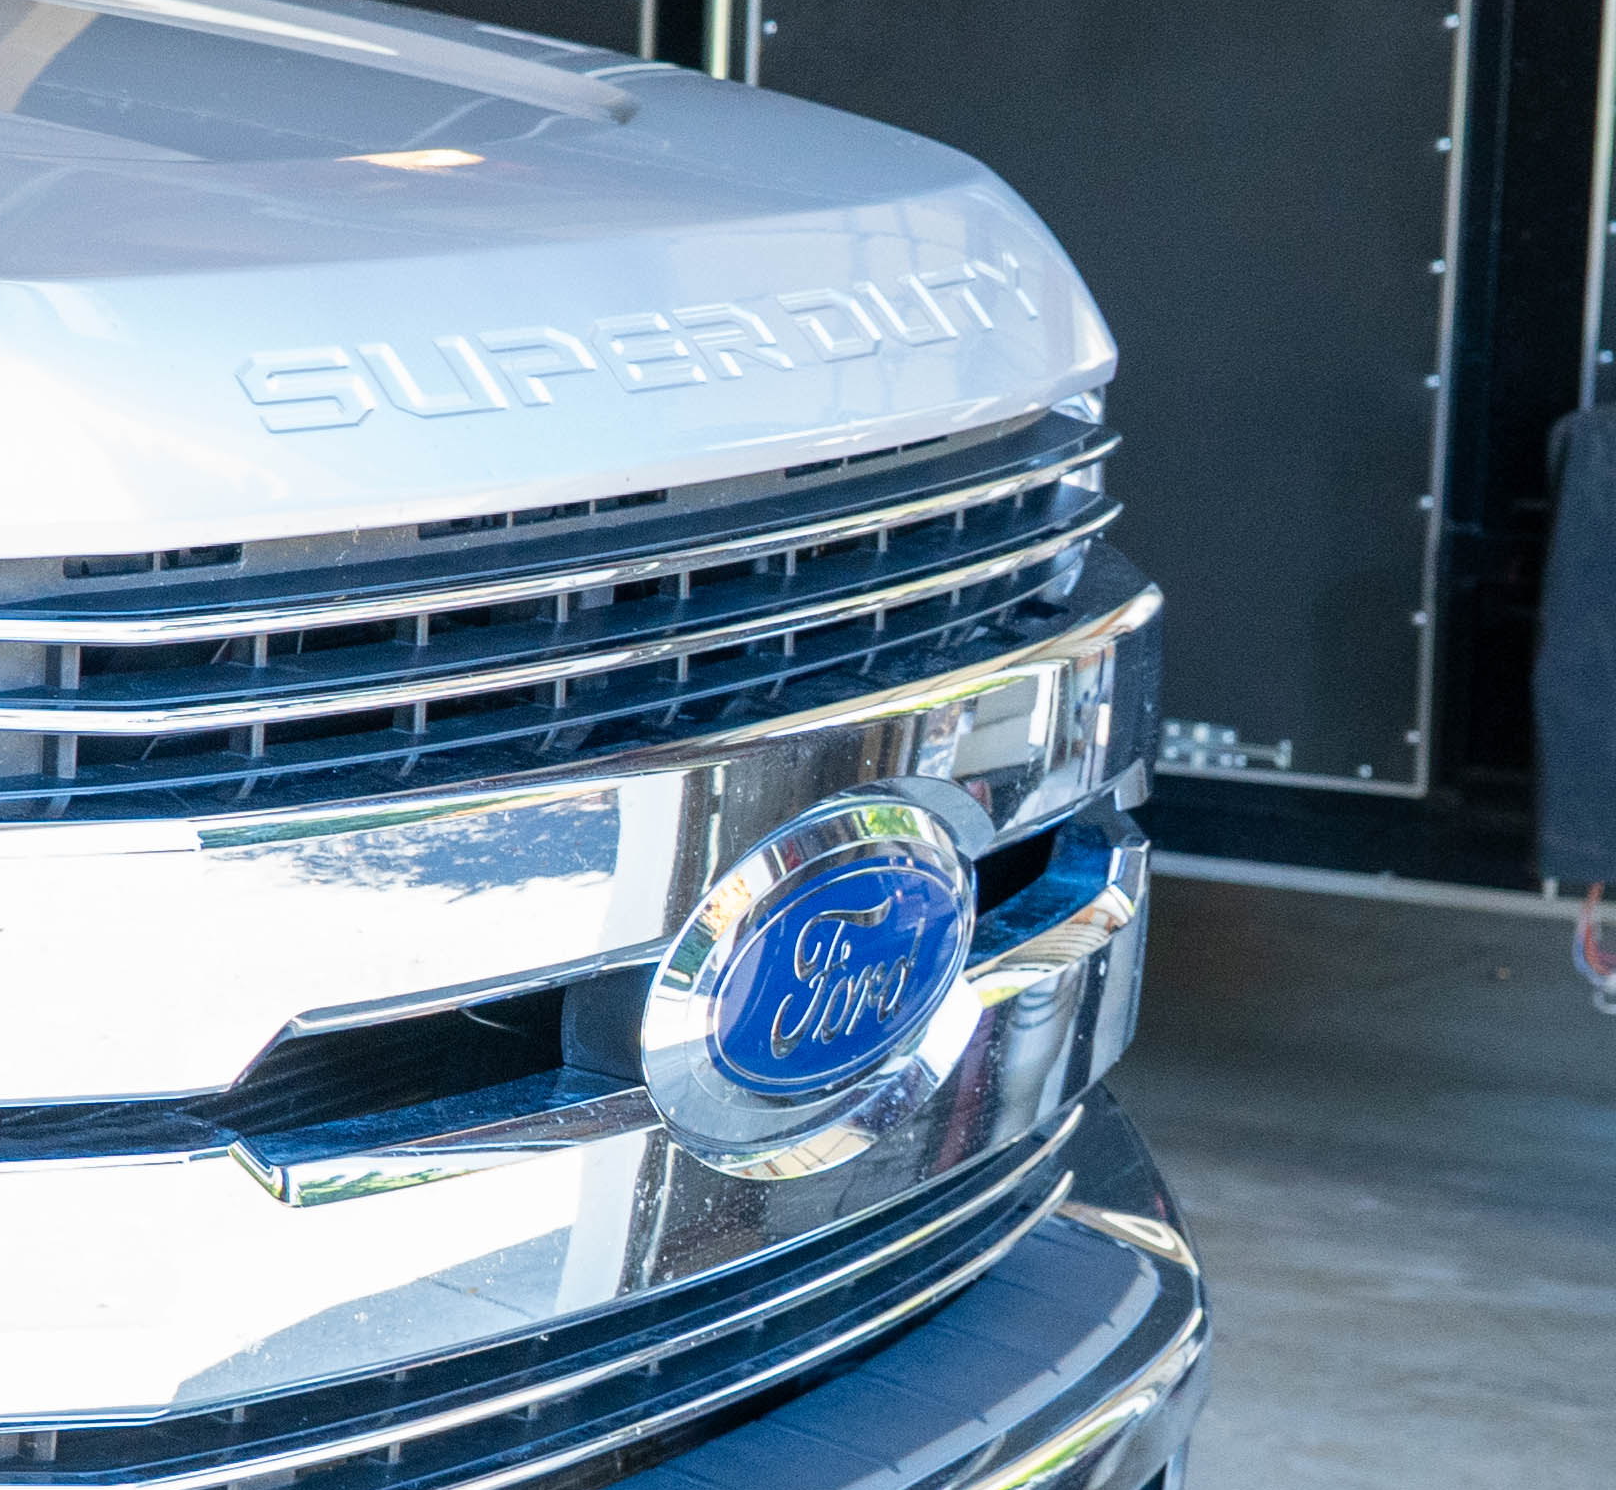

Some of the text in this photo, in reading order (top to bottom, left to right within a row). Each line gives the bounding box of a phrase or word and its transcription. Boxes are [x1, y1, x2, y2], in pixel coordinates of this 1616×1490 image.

[234, 249, 1040, 435] SUPER DUTY
[770, 896, 926, 1060] Ford
